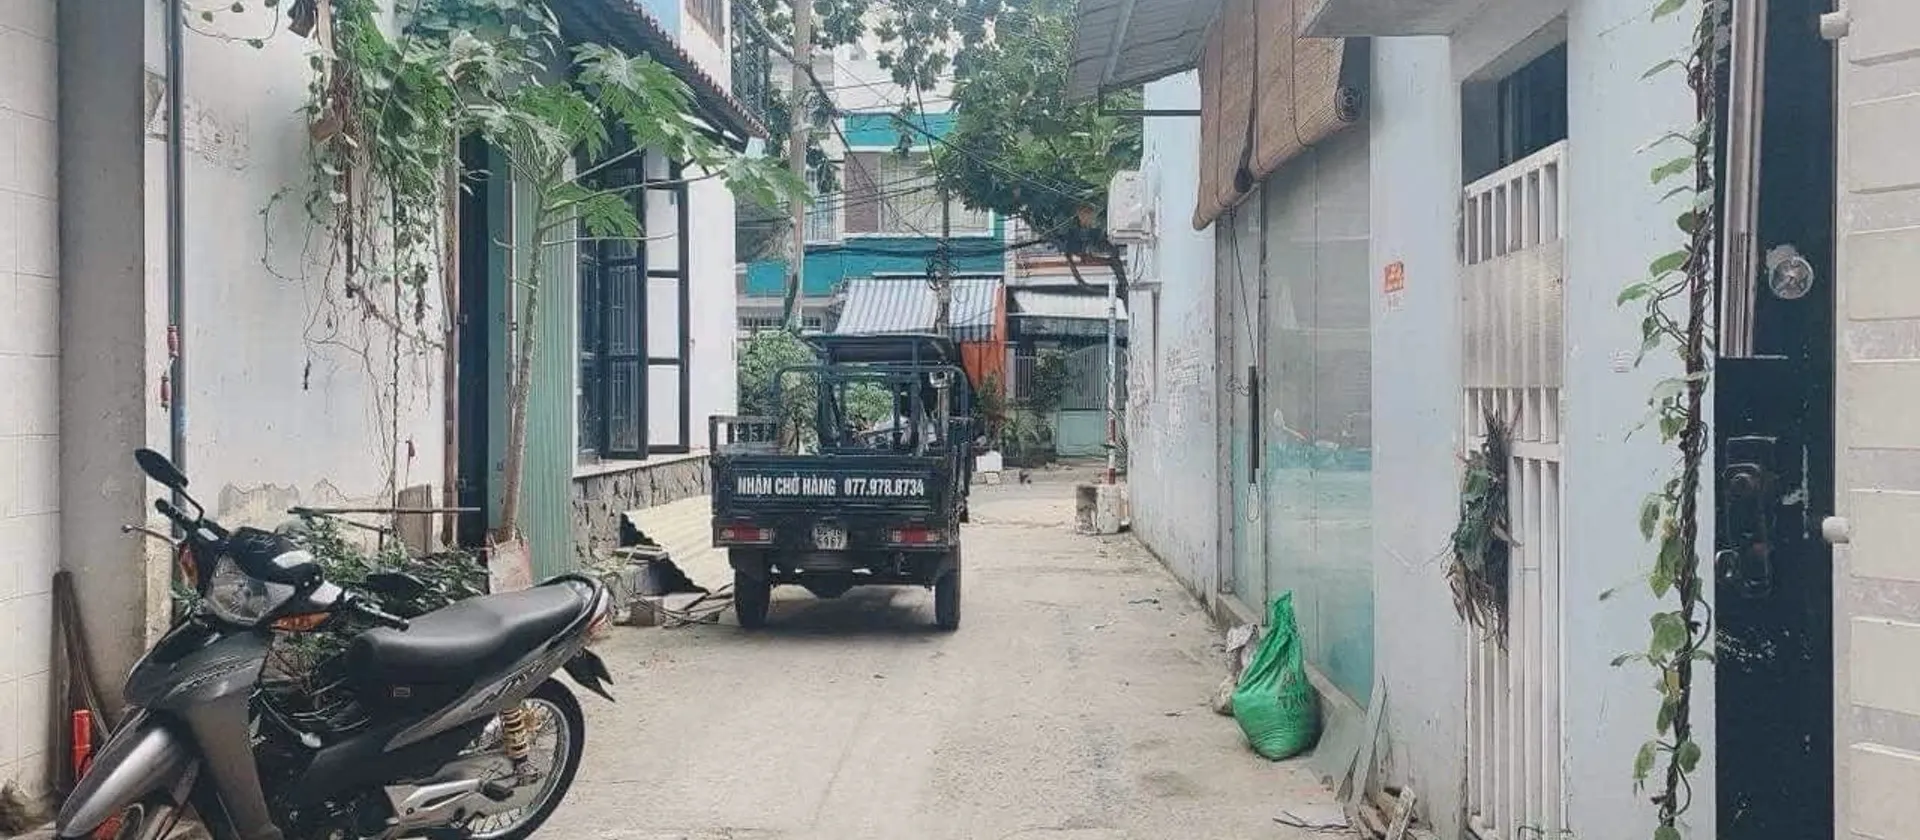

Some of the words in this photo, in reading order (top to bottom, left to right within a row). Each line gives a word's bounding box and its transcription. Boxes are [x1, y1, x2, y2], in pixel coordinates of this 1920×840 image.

[738, 474, 772, 498] NHẬN
[775, 472, 800, 495] CHỞ
[803, 474, 836, 496] HÀNG
[844, 478, 924, 496] 077.978.8734
